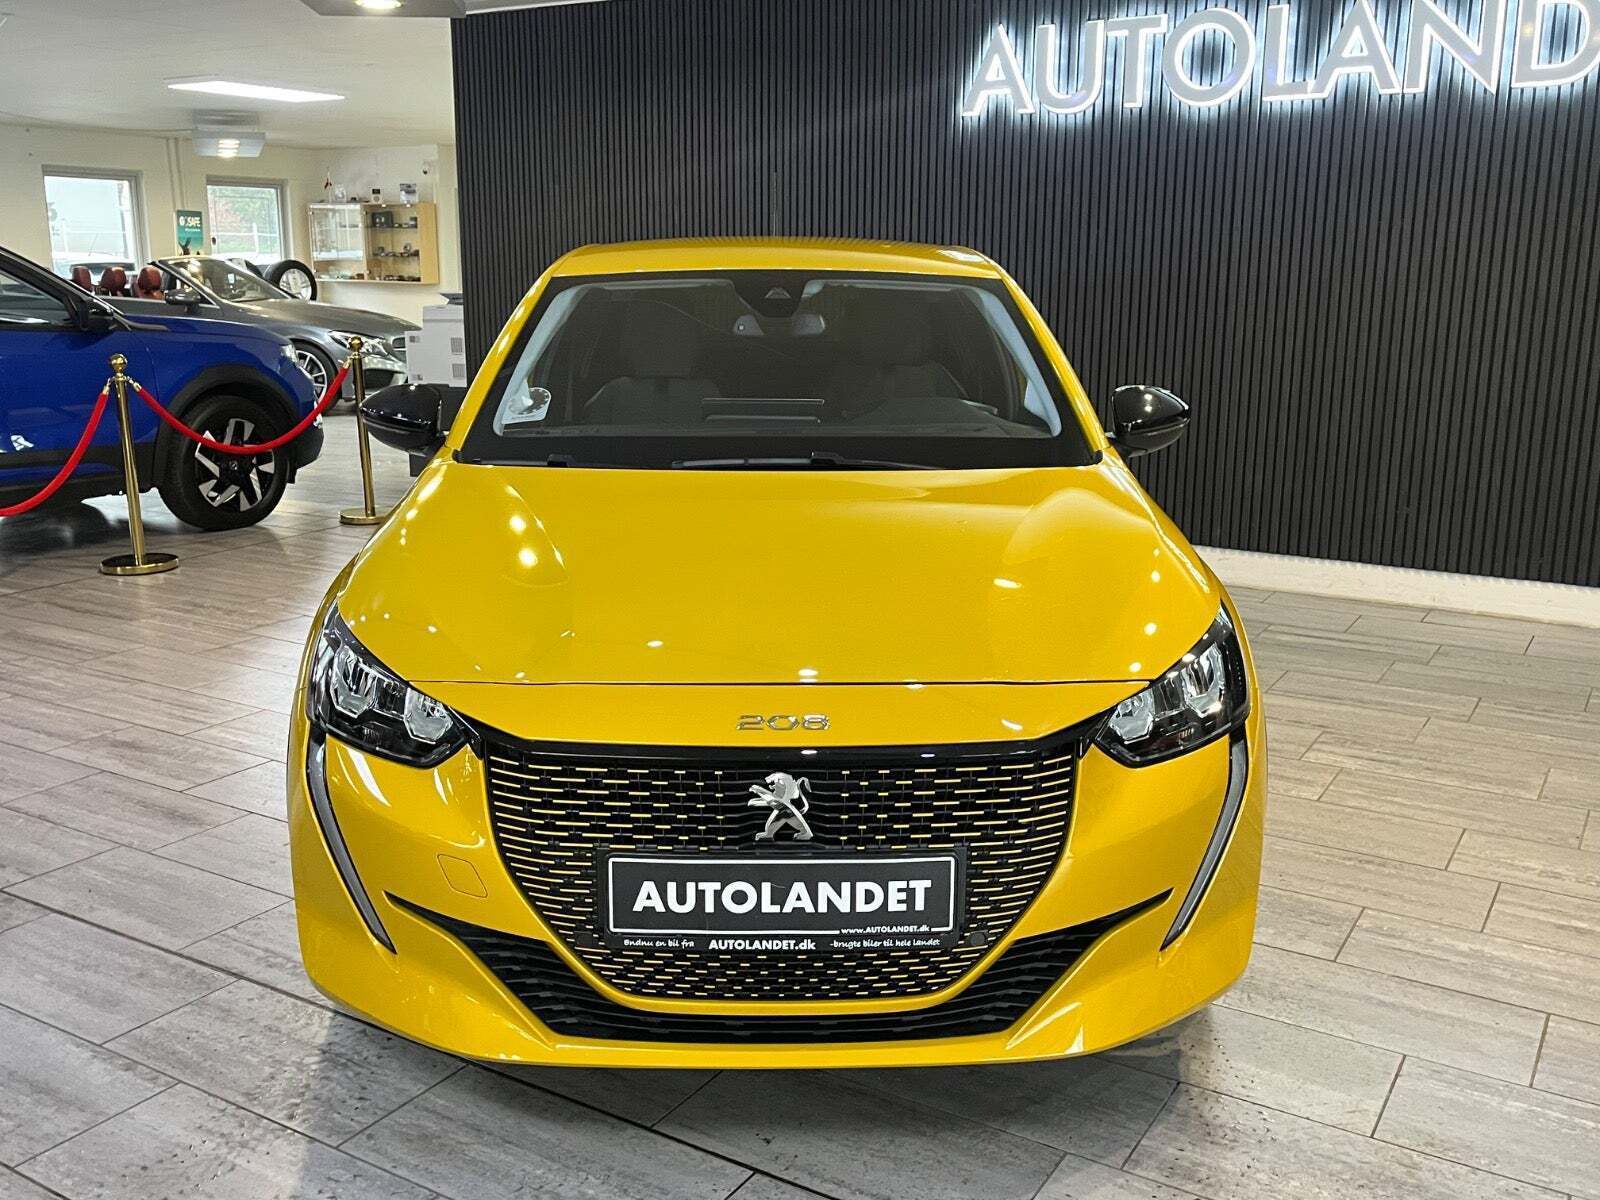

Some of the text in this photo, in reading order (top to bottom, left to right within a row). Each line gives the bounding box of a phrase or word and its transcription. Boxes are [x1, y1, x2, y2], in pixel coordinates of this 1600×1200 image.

[962, 0, 1600, 117] AUTOLAND
[736, 714, 830, 731] 208
[632, 879, 932, 914] AUTOLANDET
[840, 924, 930, 934] www.AUTOLANDET.dk
[667, 938, 680, 947] bil
[681, 938, 695, 950] fra
[708, 938, 817, 951] AUTOLANDET.dk
[862, 938, 882, 948] biler
[883, 938, 894, 948] til
[895, 938, 912, 947] hele
[912, 937, 941, 947] landet
